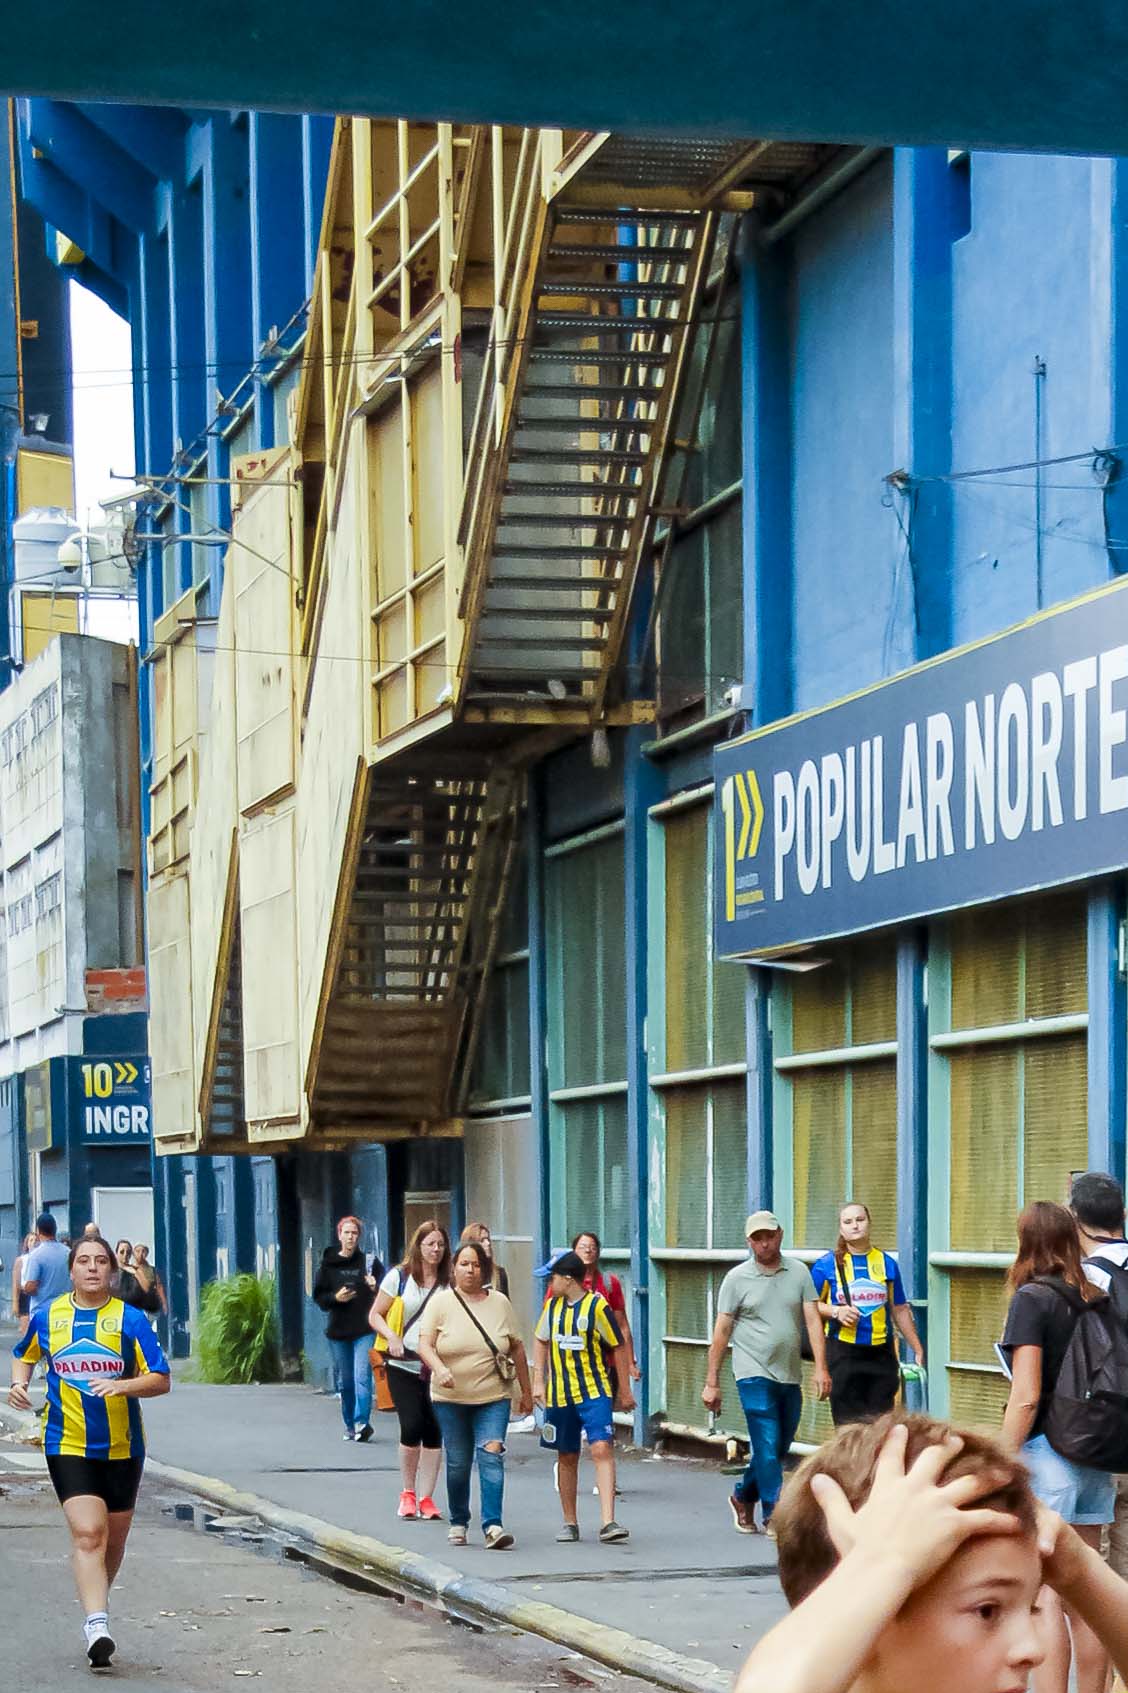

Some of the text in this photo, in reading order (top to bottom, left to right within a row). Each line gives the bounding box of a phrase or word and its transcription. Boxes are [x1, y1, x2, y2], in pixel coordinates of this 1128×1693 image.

[773, 712, 955, 901] POPULAR
[81, 1062, 113, 1098] 10
[54, 1359, 124, 1374] PALADINI
